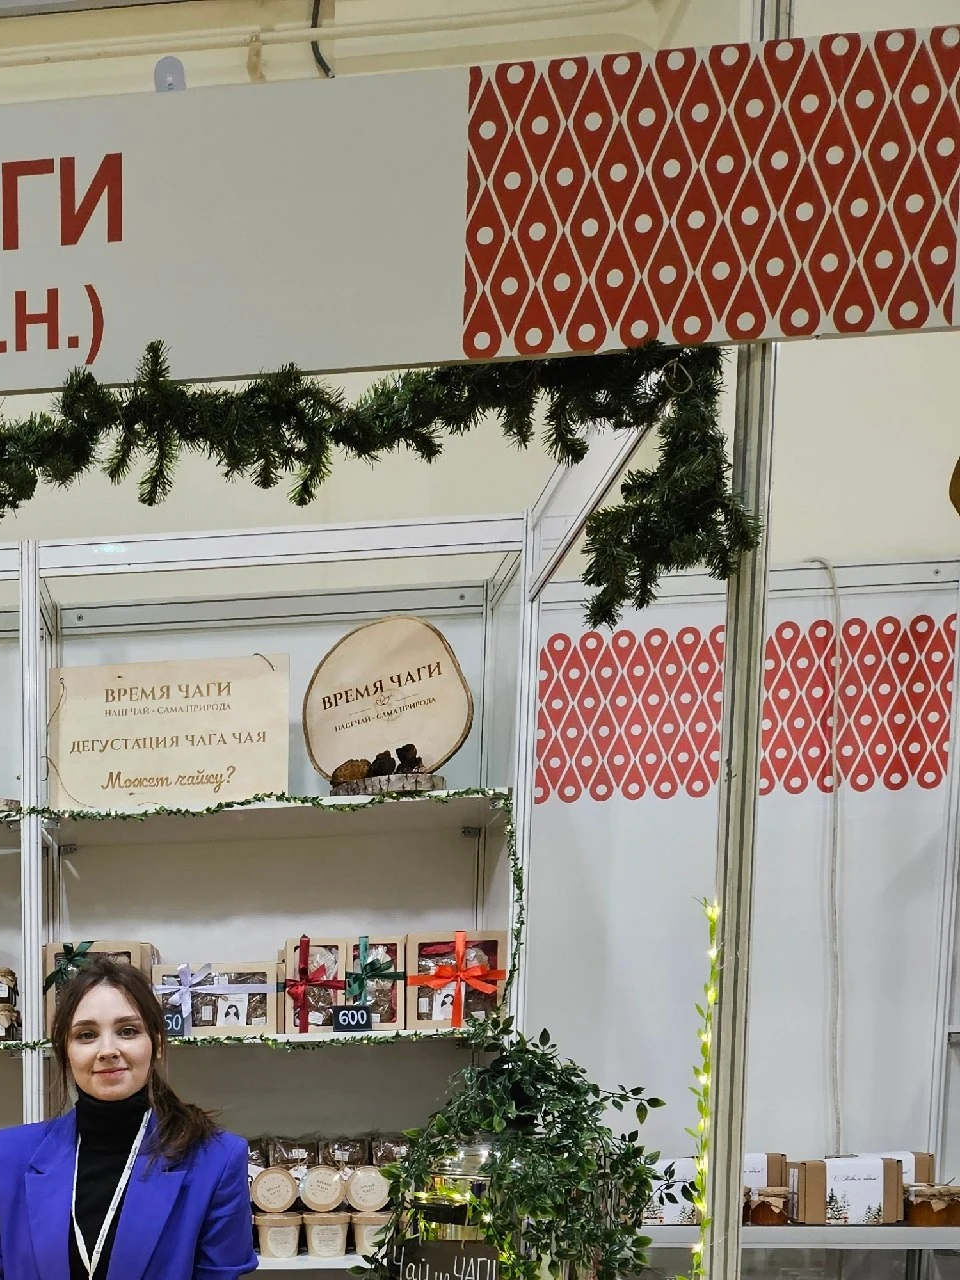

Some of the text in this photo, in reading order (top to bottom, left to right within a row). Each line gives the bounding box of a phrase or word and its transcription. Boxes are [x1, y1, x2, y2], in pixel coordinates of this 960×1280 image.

[104, 681, 232, 703] ВРЕМЯ ЧАГИ
[321, 661, 443, 711] ВРЕМЯ ЧАГИ
[157, 705, 184, 715] САМА
[186, 702, 232, 713] ПРИРОДА
[69, 731, 267, 754] ДЕГУСТАЦИЯ ЧАГА ЧАЯ
[101, 765, 237, 793] Может чайку?
[338, 1010, 368, 1026] 600
